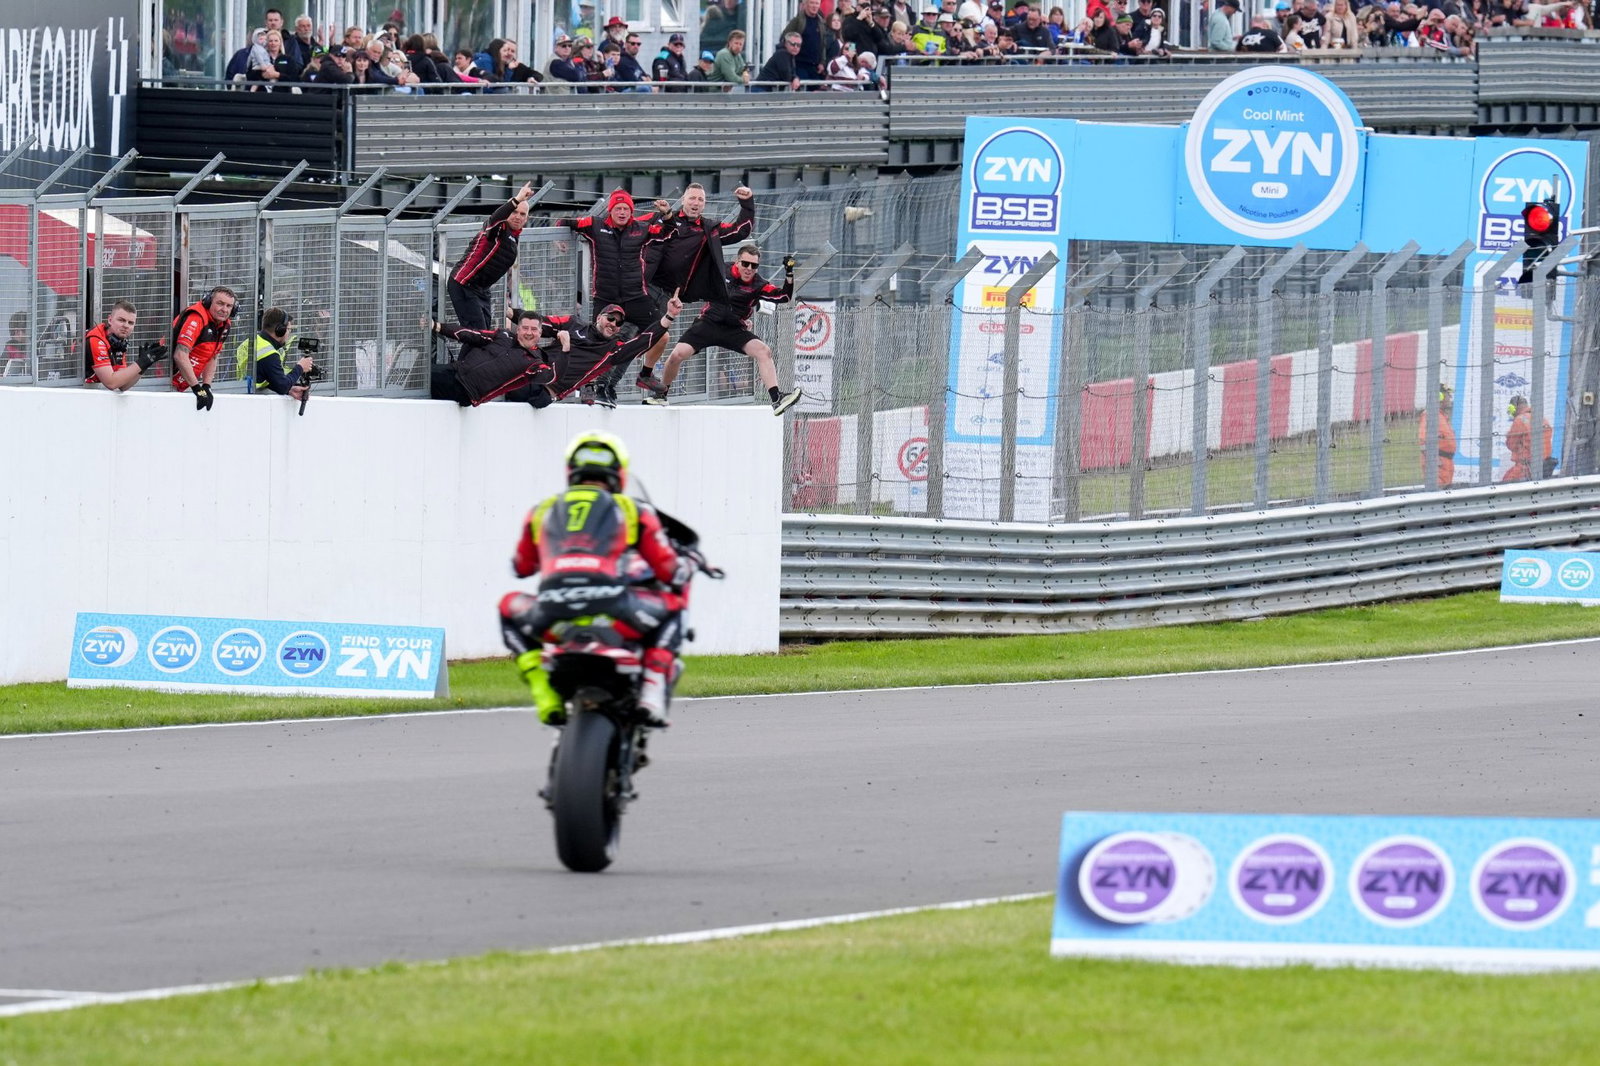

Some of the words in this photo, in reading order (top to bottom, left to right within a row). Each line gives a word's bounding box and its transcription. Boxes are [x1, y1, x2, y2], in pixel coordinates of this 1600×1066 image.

[1243, 108, 1273, 120] Cool
[1275, 109, 1305, 122] Mint
[1210, 128, 1333, 176] ZYN
[983, 157, 1052, 182] ZYN
[1261, 186, 1280, 195] Mini
[1492, 177, 1561, 204] ZYN
[976, 196, 1053, 221] BSB
[1239, 204, 1267, 218] Nicotine
[1268, 208, 1299, 219] Pouches
[1005, 220, 1053, 228] SUPERBIKES
[566, 501, 592, 532] 1
[1511, 567, 1539, 578] ZYN
[1563, 569, 1590, 579] ZYN
[84, 639, 122, 653] ZYN
[155, 642, 194, 656] ZYN
[341, 635, 380, 648] FIND
[386, 637, 432, 650] YOUR
[219, 644, 259, 660] ZYN
[283, 647, 324, 661] ZYN
[336, 647, 432, 680] ZYN
[1095, 866, 1171, 889] ZYN
[1243, 868, 1320, 892] ZYN
[1363, 870, 1441, 894] ZYN
[1485, 872, 1562, 897] ZYN
